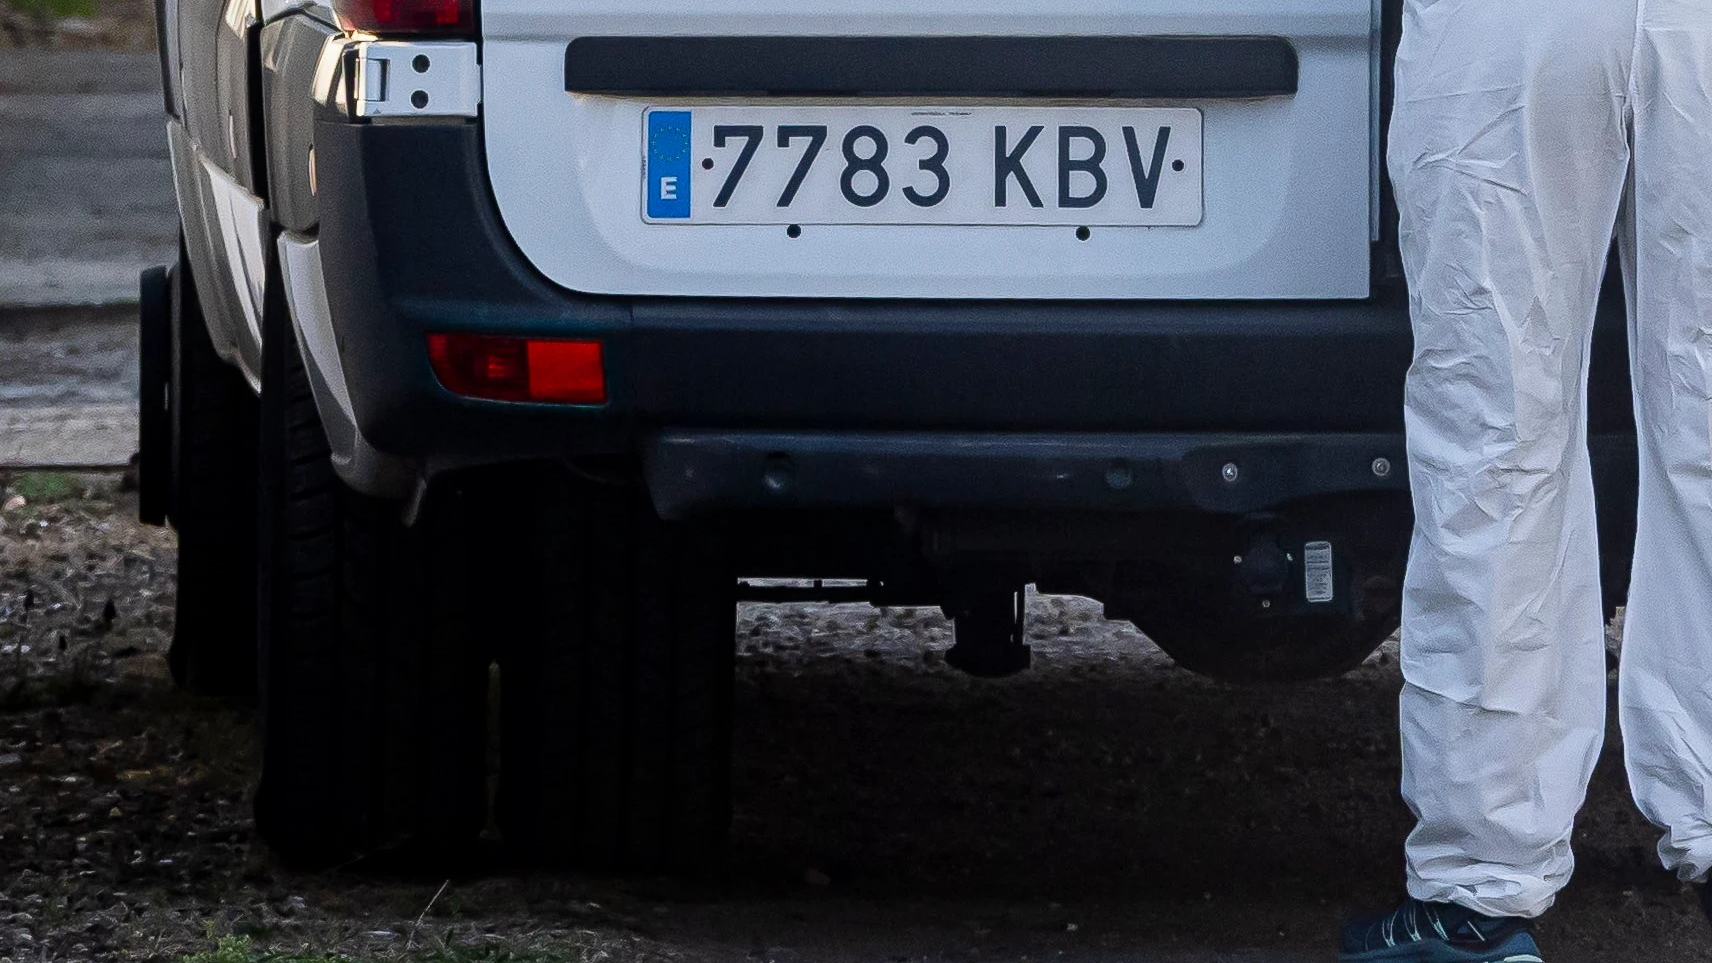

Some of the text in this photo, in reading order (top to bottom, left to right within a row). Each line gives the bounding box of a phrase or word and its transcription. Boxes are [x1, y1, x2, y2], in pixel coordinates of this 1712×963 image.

[660, 176, 678, 200] E
[712, 125, 1171, 209] 7783 KBV
